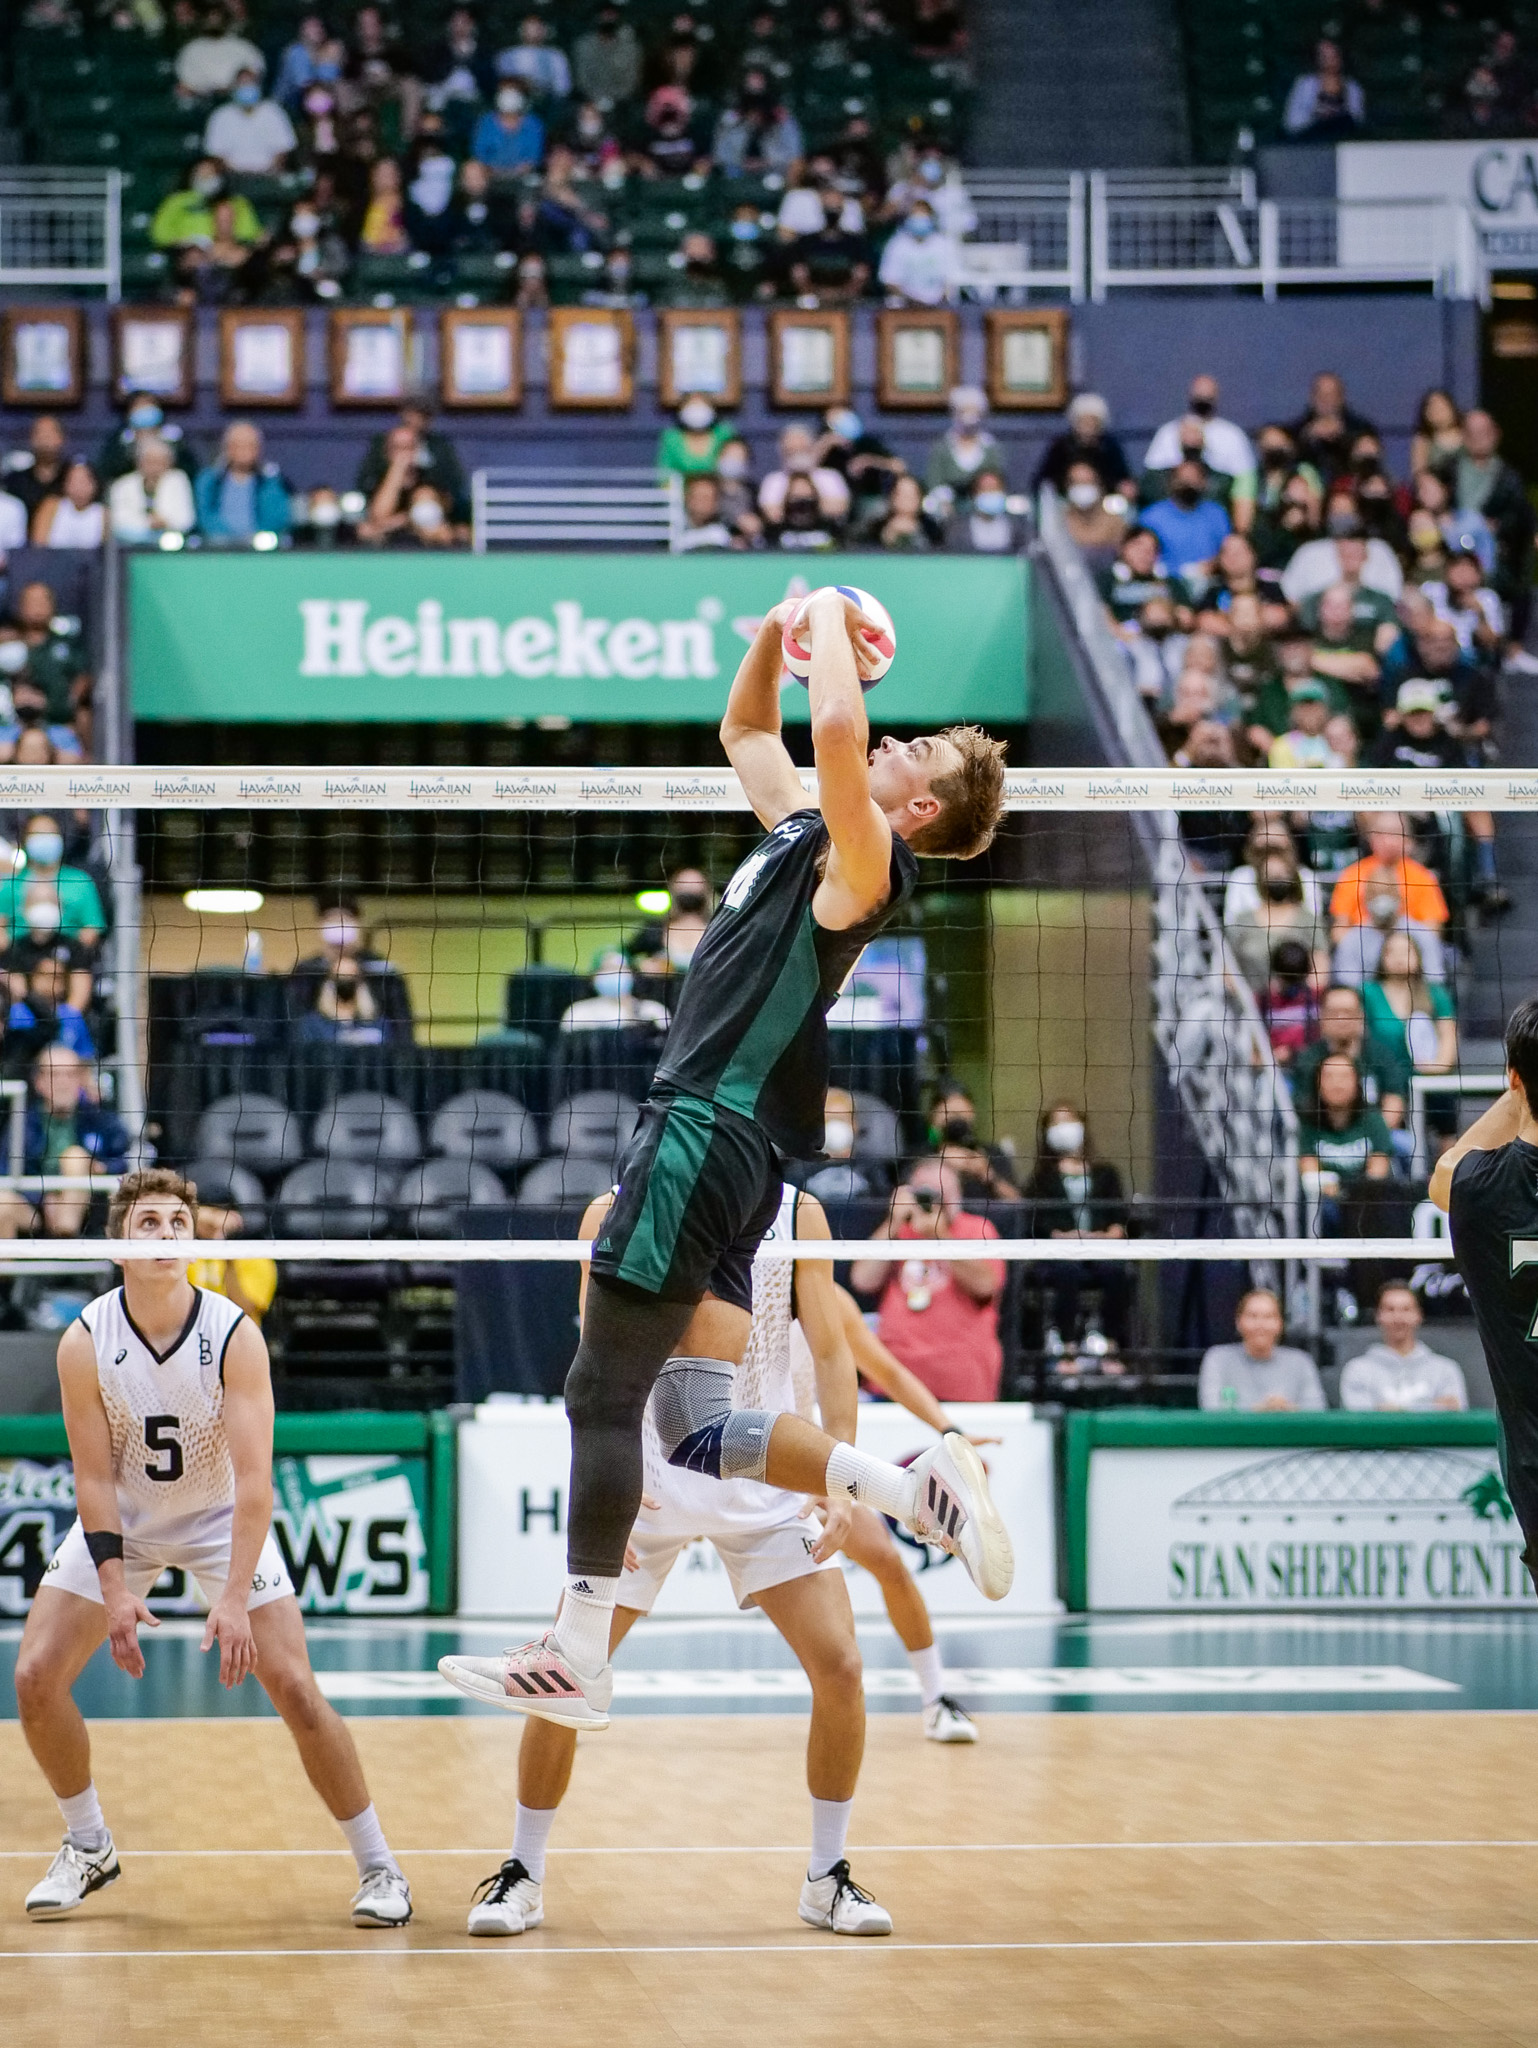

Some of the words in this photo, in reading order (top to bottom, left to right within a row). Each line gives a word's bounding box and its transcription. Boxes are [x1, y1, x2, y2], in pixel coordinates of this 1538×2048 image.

[299, 598, 721, 679] Heineken
[69, 779, 130, 798] HAWAIIAN
[154, 780, 215, 798] HAWAIIAN
[239, 780, 301, 798] HAWAIIAN
[325, 780, 386, 798] HAWAIIAN
[411, 780, 471, 799] HAWAIIAN
[495, 780, 556, 799] HAWAIIAN
[581, 781, 641, 799] HAWAIIAN
[666, 781, 726, 800] HAWAIIAN
[1088, 781, 1148, 800] HAWAIIAN
[1173, 782, 1233, 800] HAWAIIAN
[1257, 782, 1316, 800] HAWAIIAN
[1341, 782, 1400, 801] HAWAIIAN
[1424, 783, 1484, 801] HAWAIIAN
[144, 1414, 184, 1482] 5
[1168, 1541, 1256, 1600] STAN
[1265, 1541, 1414, 1600] SHERIFF
